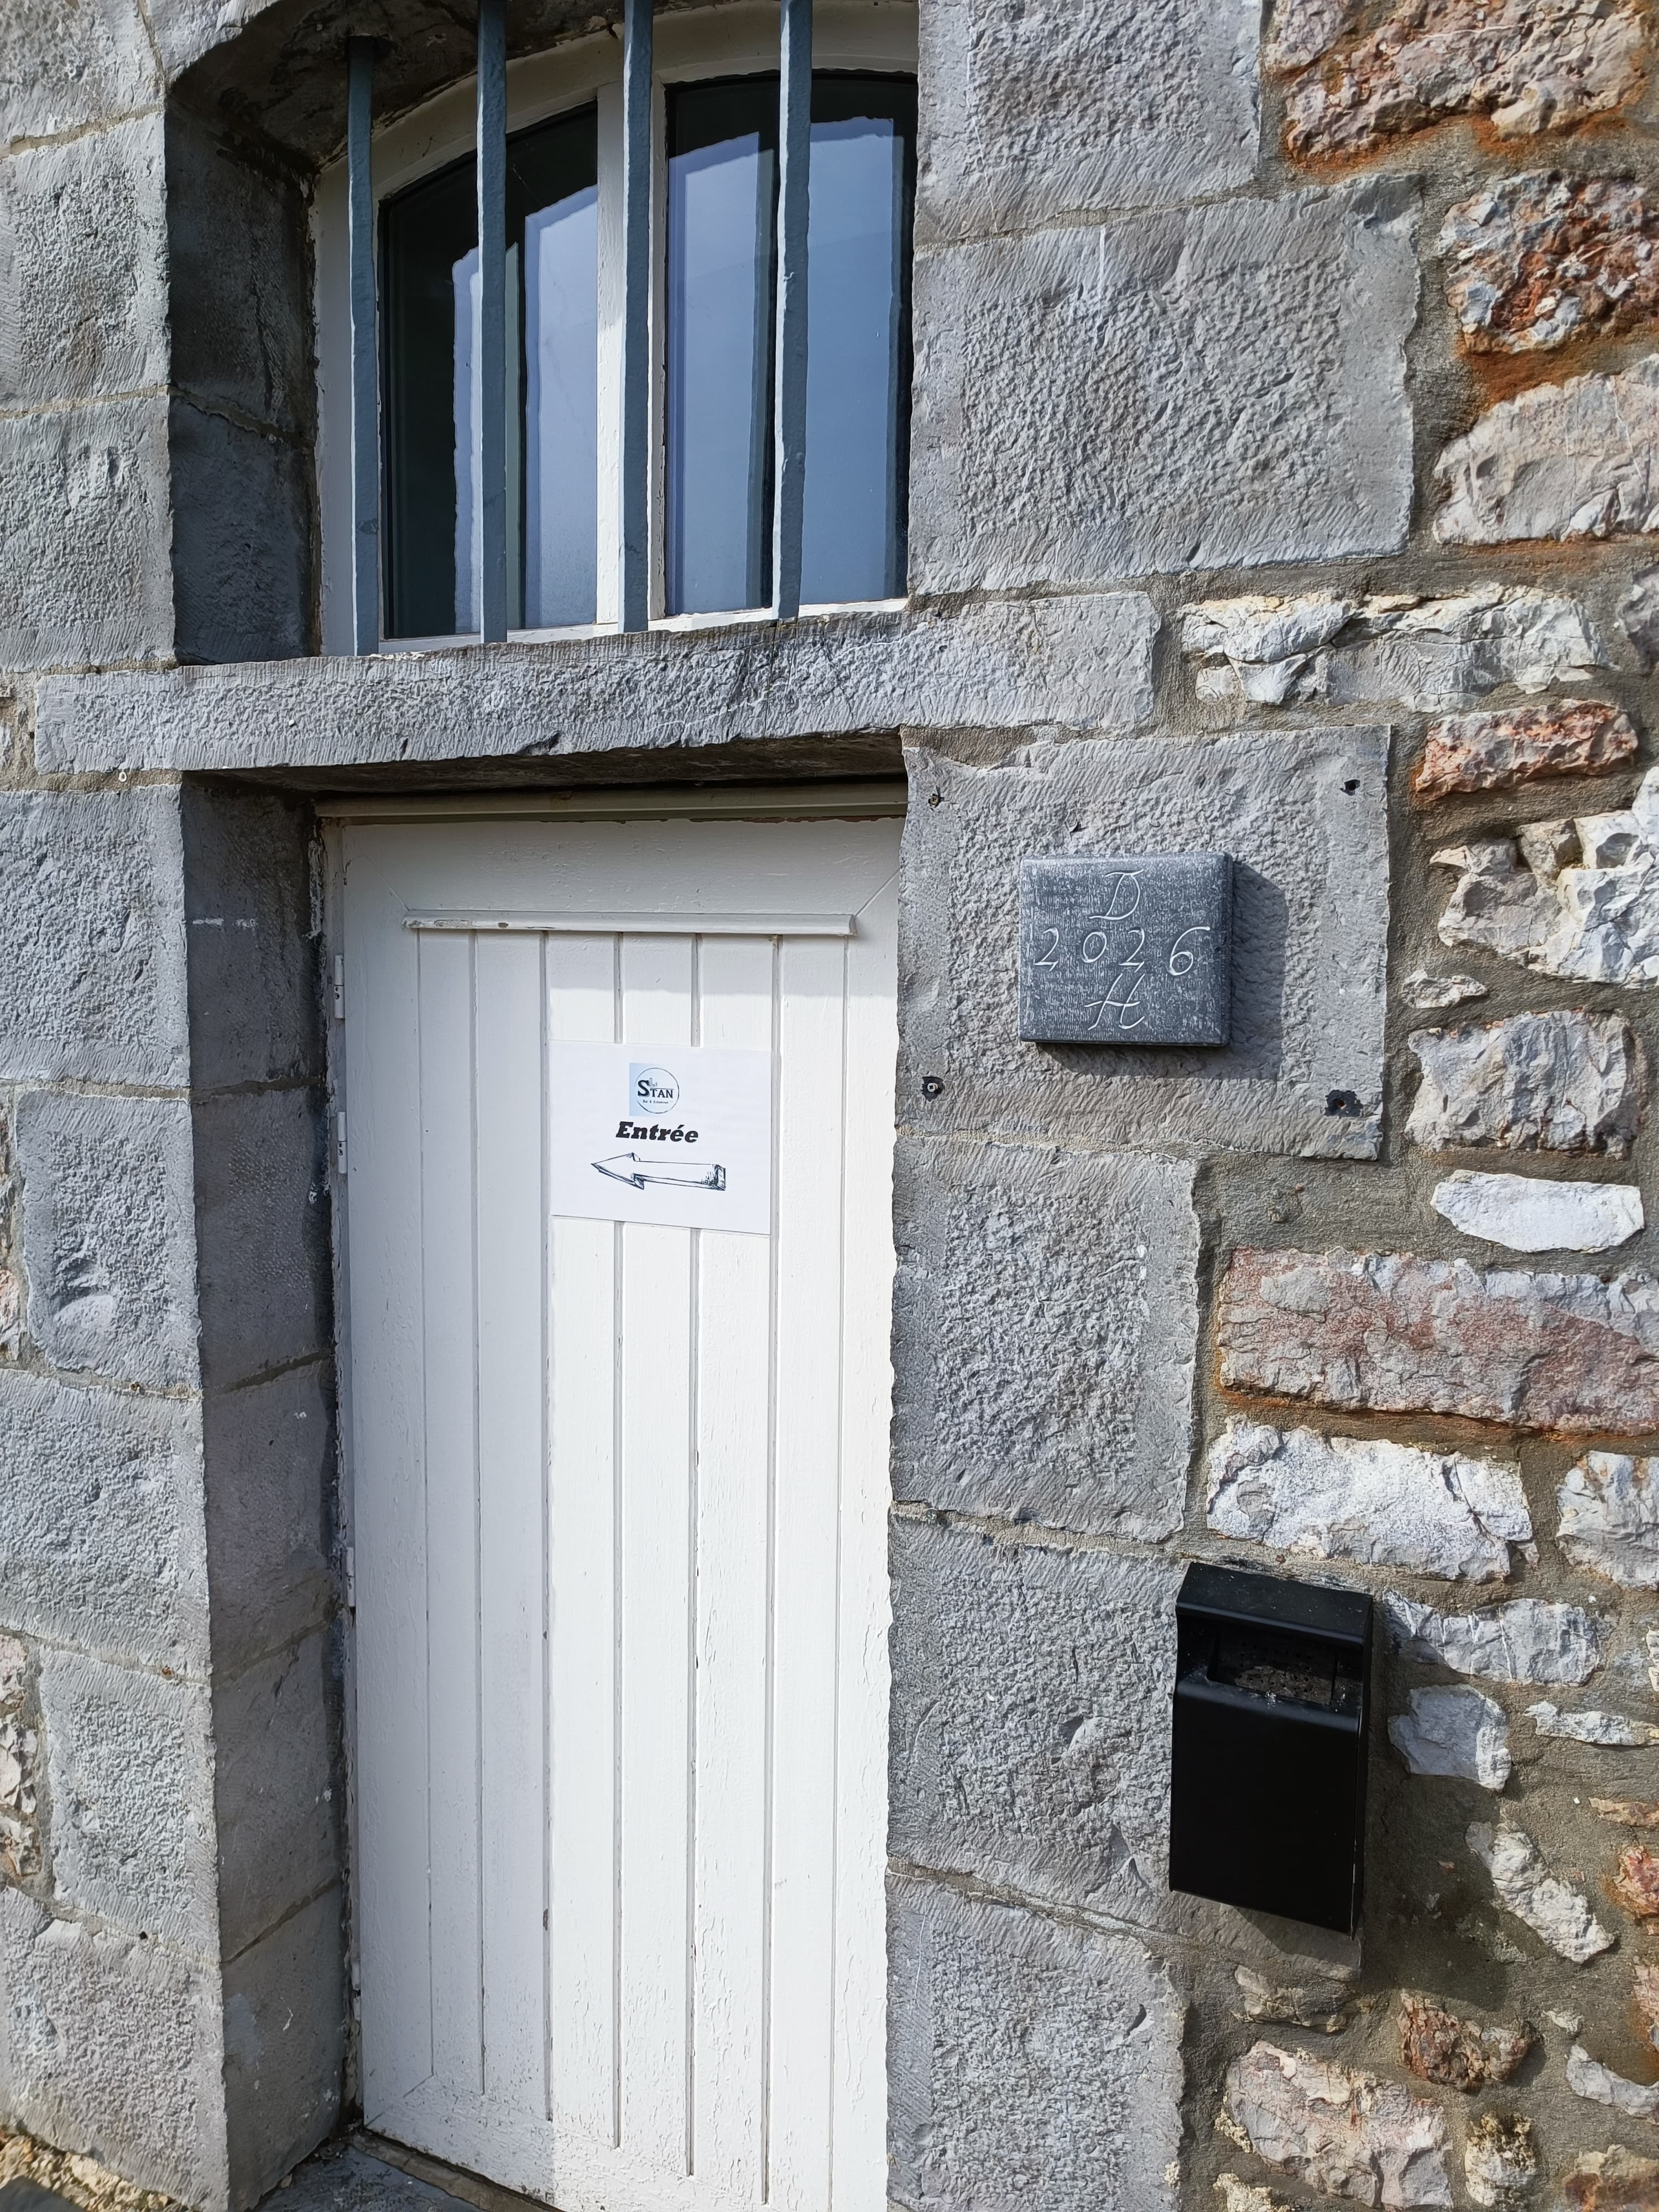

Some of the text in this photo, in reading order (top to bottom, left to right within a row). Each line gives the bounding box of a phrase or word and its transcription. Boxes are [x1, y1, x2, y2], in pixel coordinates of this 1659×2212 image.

[1089, 869, 1144, 920] D
[1033, 927, 1211, 976] 2026
[1084, 973, 1145, 1031] H
[615, 1121, 698, 1143] Entrée
